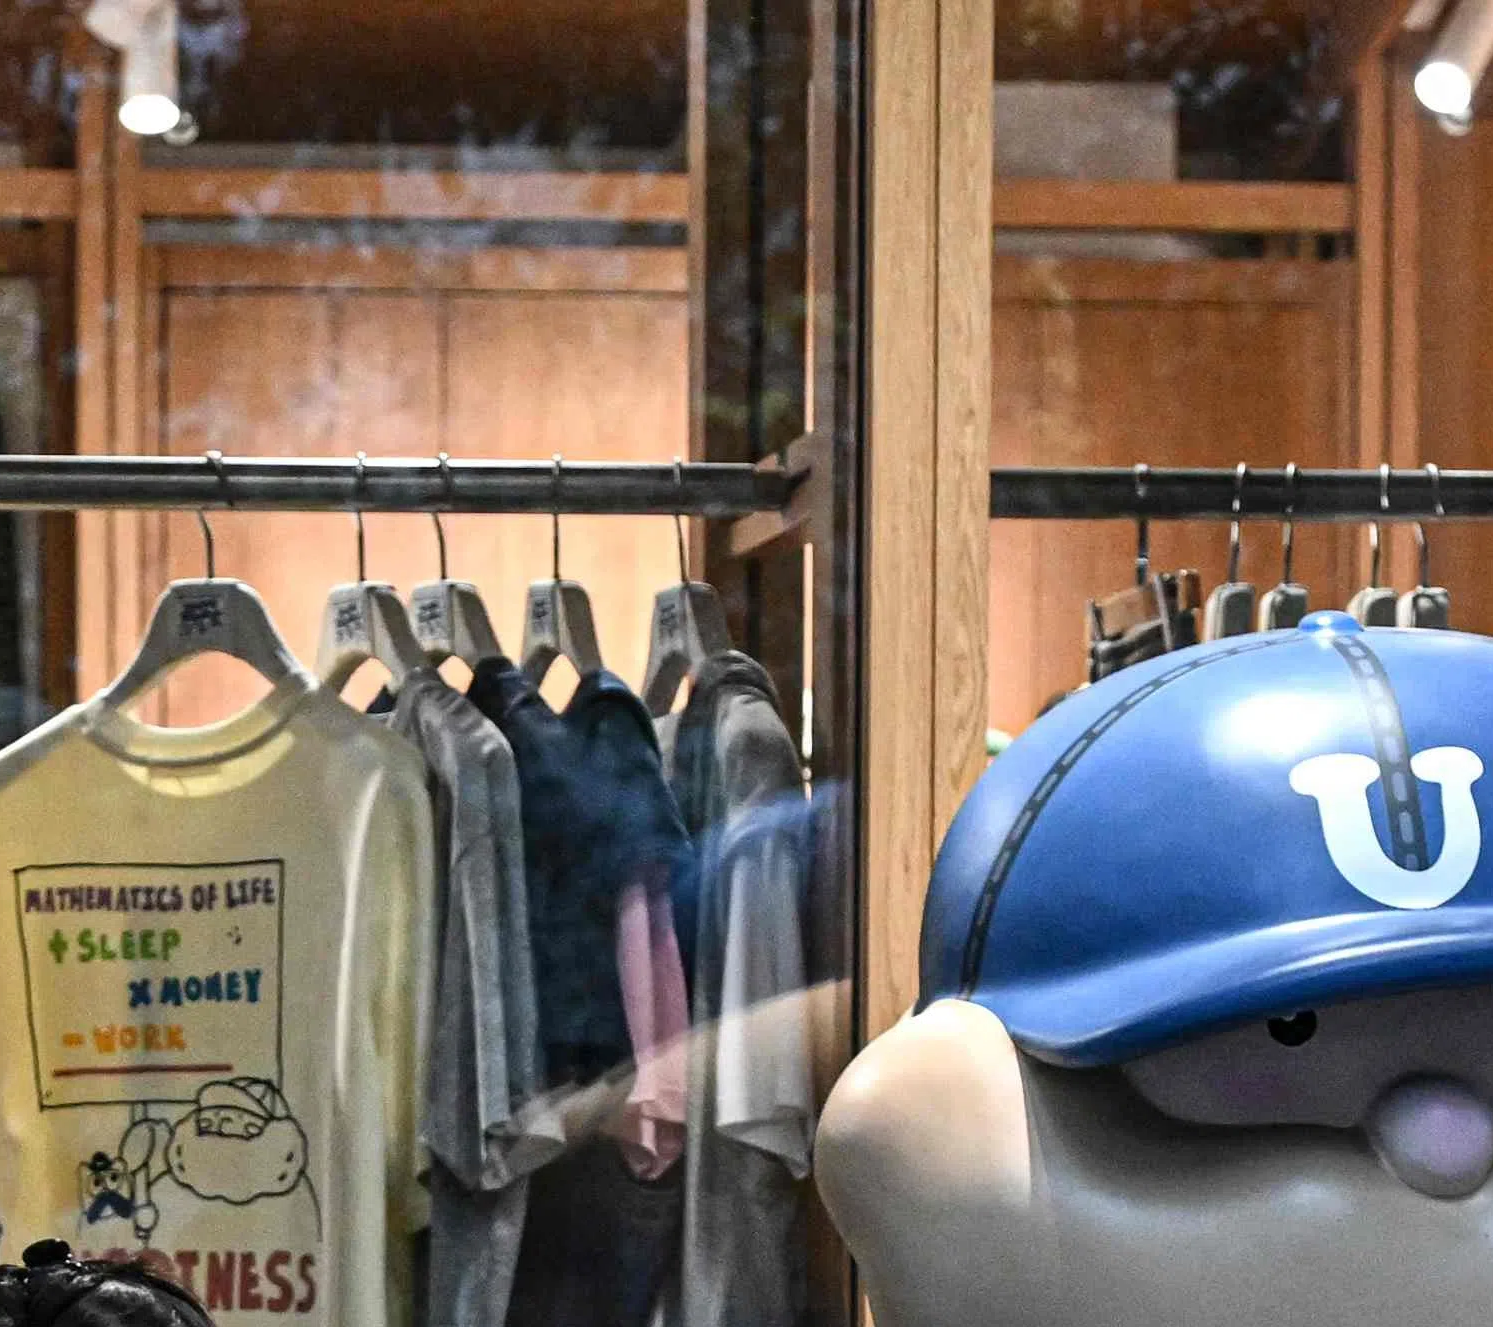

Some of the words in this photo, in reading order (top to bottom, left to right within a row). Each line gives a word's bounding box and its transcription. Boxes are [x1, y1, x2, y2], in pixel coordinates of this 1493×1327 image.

[1288, 746, 1485, 909] U
[25, 882, 183, 913] MATHEMATICS
[190, 882, 218, 912] OF
[225, 876, 275, 908] LIFE
[73, 1246, 318, 1314] INESS
